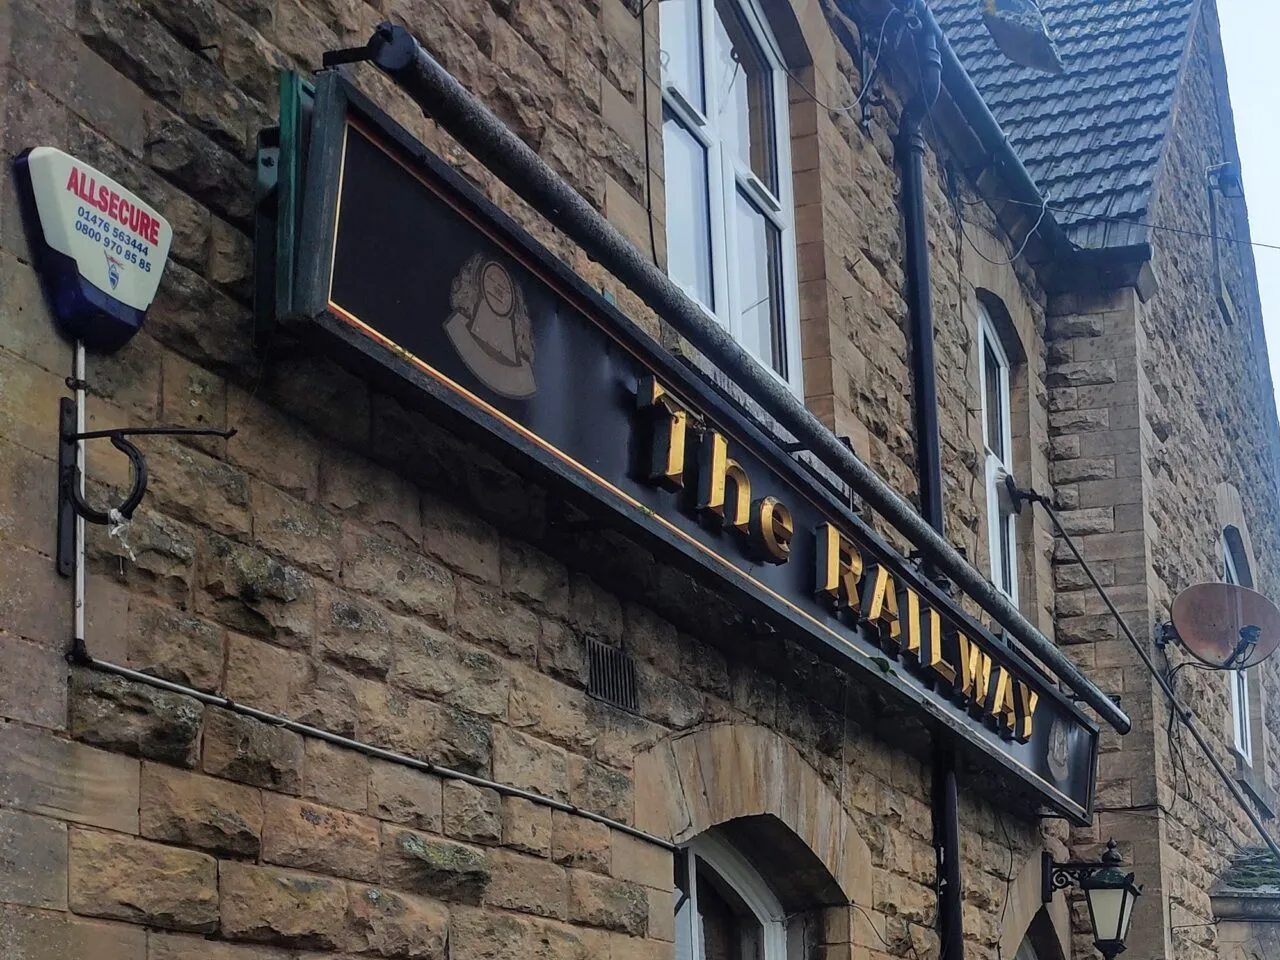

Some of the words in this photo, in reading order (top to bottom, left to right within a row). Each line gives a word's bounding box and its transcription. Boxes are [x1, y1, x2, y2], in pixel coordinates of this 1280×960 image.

[67, 166, 160, 247] ALLSECURE
[78, 206, 110, 233] 01476
[112, 227, 149, 256] 563444
[75, 220, 101, 242] 0800
[103, 237, 123, 255] 970
[124, 250, 137, 264] 85
[138, 258, 152, 272] 85
[637, 375, 794, 565] The
[814, 521, 1039, 743] RAILWAY
